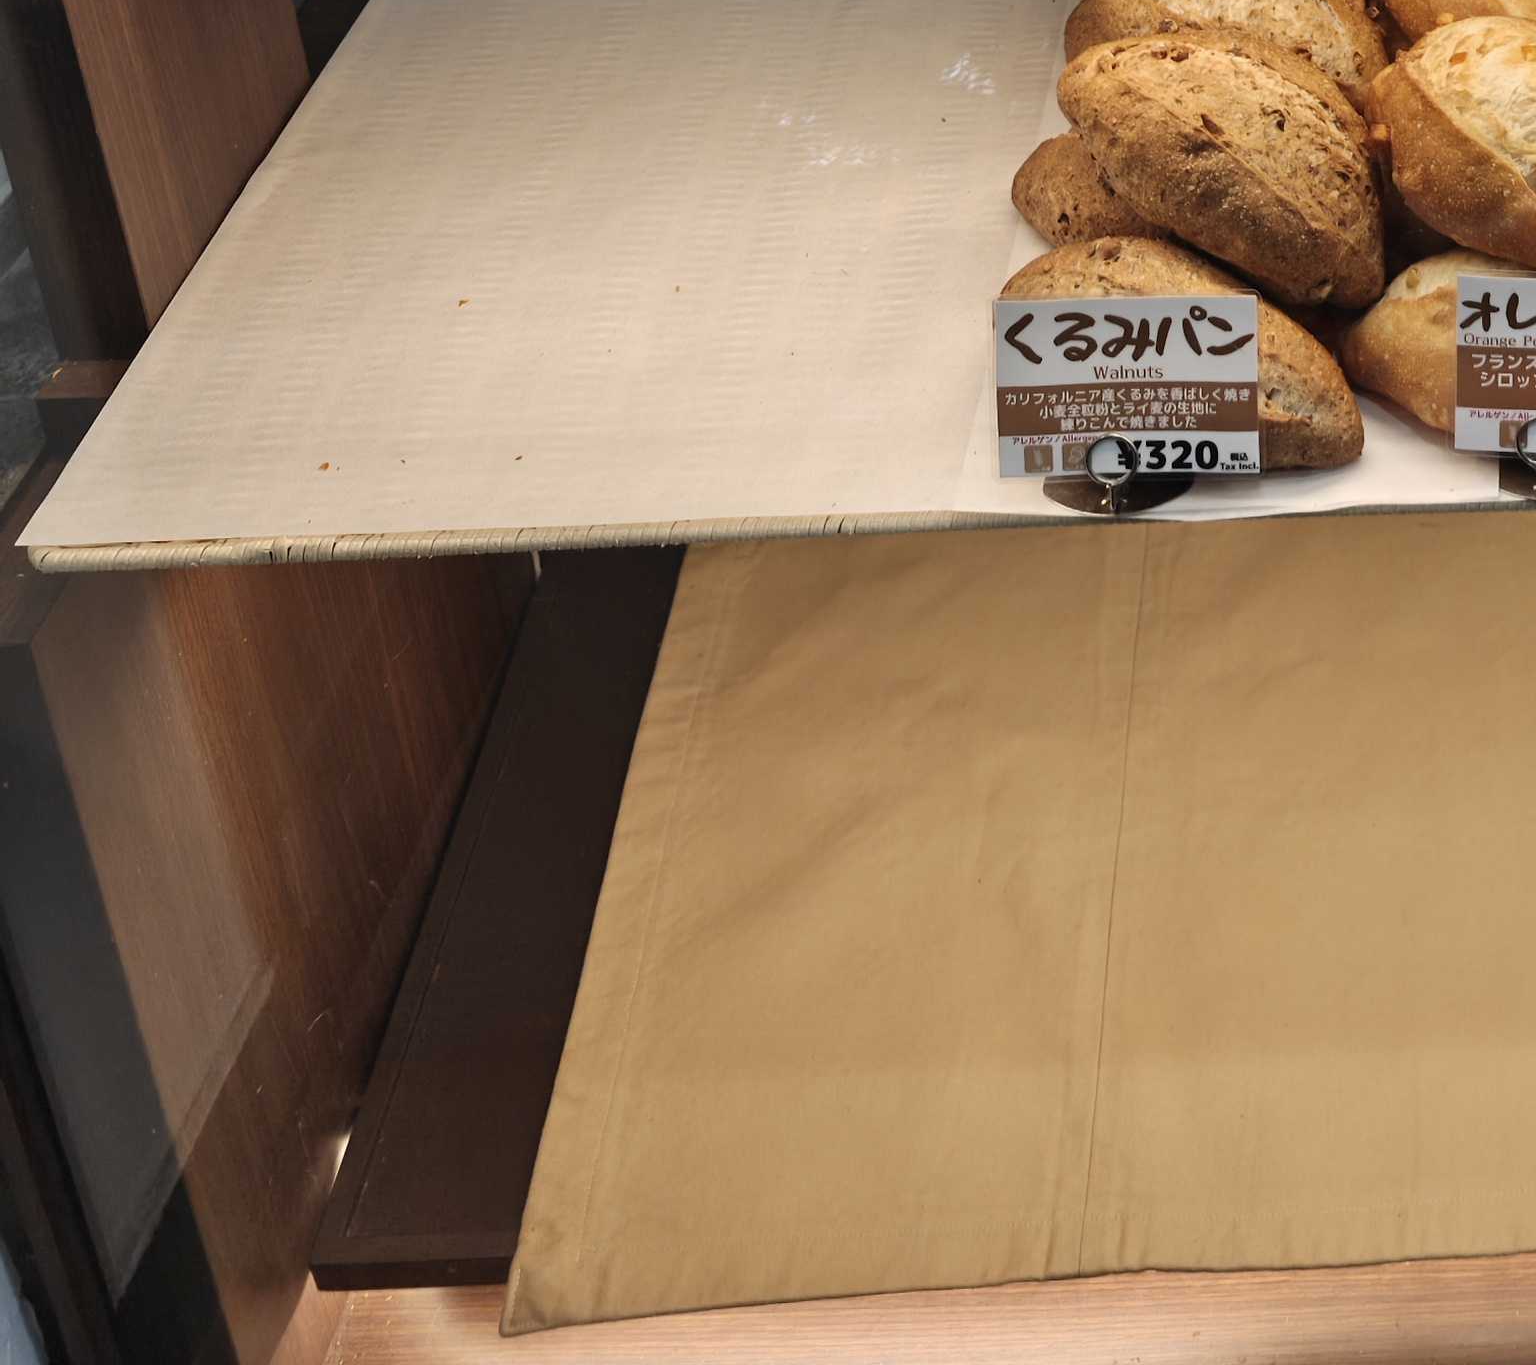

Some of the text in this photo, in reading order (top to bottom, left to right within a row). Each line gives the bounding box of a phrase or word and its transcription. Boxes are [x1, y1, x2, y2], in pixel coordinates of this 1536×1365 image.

[1004, 305, 1254, 365] くるみパン
[1464, 333, 1516, 349] Orange
[1094, 366, 1164, 380] Walnuts
[1118, 439, 1219, 470] ¥320
